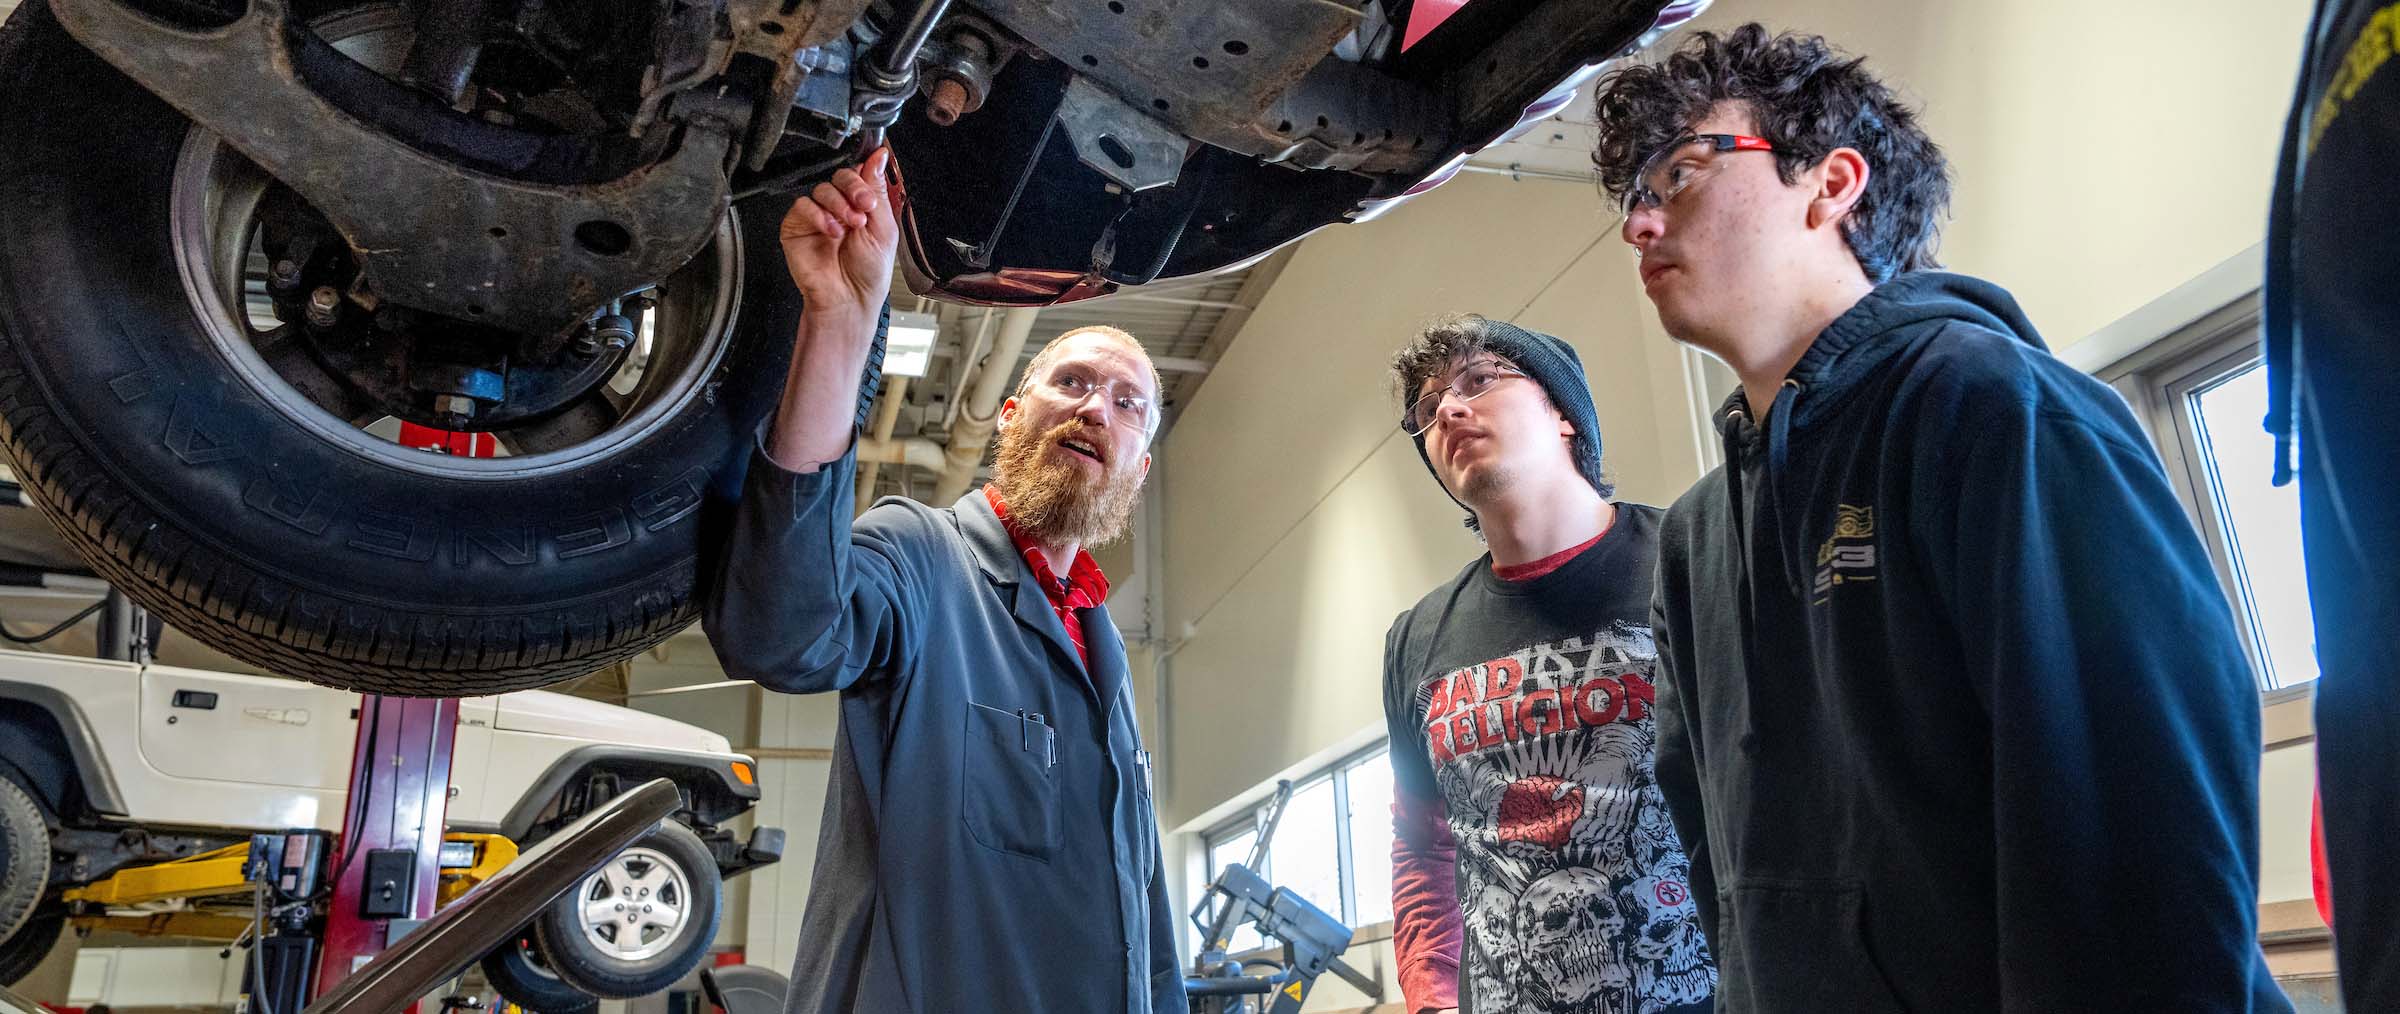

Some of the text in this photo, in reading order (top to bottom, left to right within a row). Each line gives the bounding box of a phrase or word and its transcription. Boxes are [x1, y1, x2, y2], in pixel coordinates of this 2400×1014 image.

[108, 318, 713, 567] GENERAL
[1427, 657, 1524, 723] BAD
[1428, 672, 1656, 770] RELIGION
